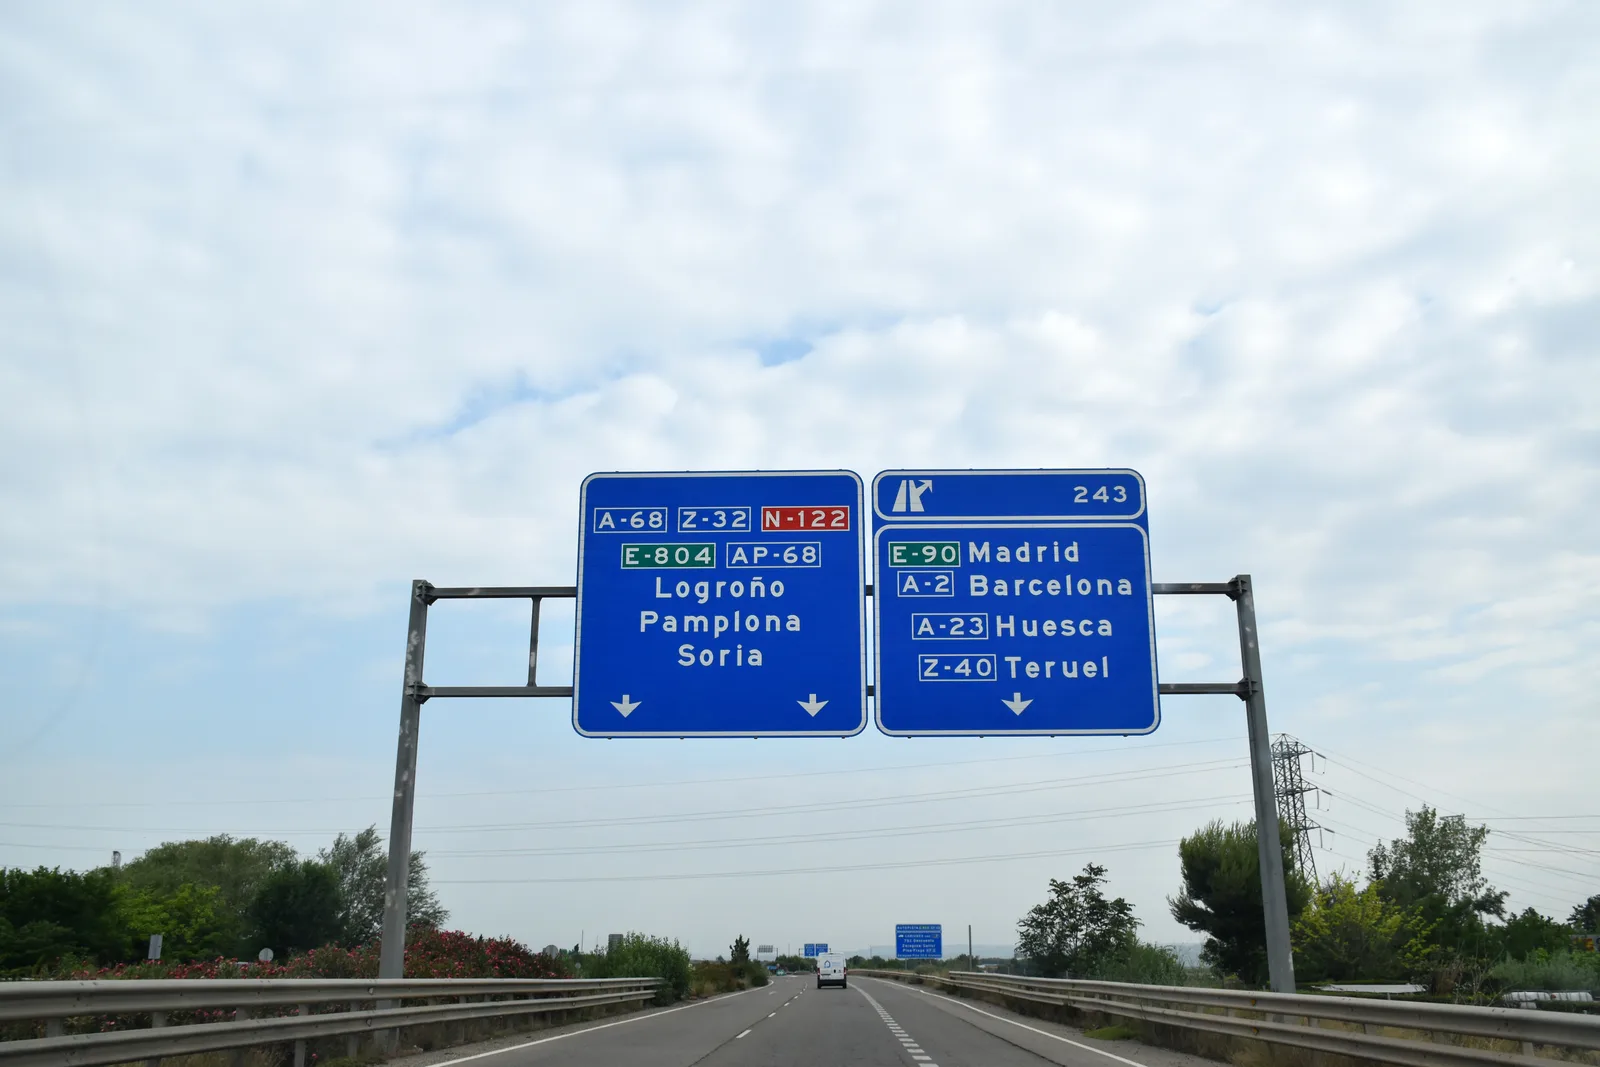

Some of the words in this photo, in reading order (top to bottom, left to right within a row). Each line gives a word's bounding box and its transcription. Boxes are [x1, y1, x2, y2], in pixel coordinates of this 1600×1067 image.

[1074, 486, 1126, 502] 243
[599, 512, 662, 528] A-68
[683, 511, 746, 528] Z-32
[766, 510, 845, 527] N-122
[626, 547, 711, 564] E-804
[732, 546, 816, 563] AP-68
[894, 546, 955, 562] E-90
[969, 541, 1078, 562] Madrid
[656, 577, 784, 603] Logroño
[903, 575, 949, 592] A-2
[970, 575, 1131, 596] Barcelona
[641, 611, 800, 638] Pamplona
[918, 618, 983, 635] A-23
[997, 616, 1112, 636] Huesca
[678, 644, 762, 666] Soria
[924, 659, 991, 676] Z-40
[1005, 656, 1108, 678] Teruel
